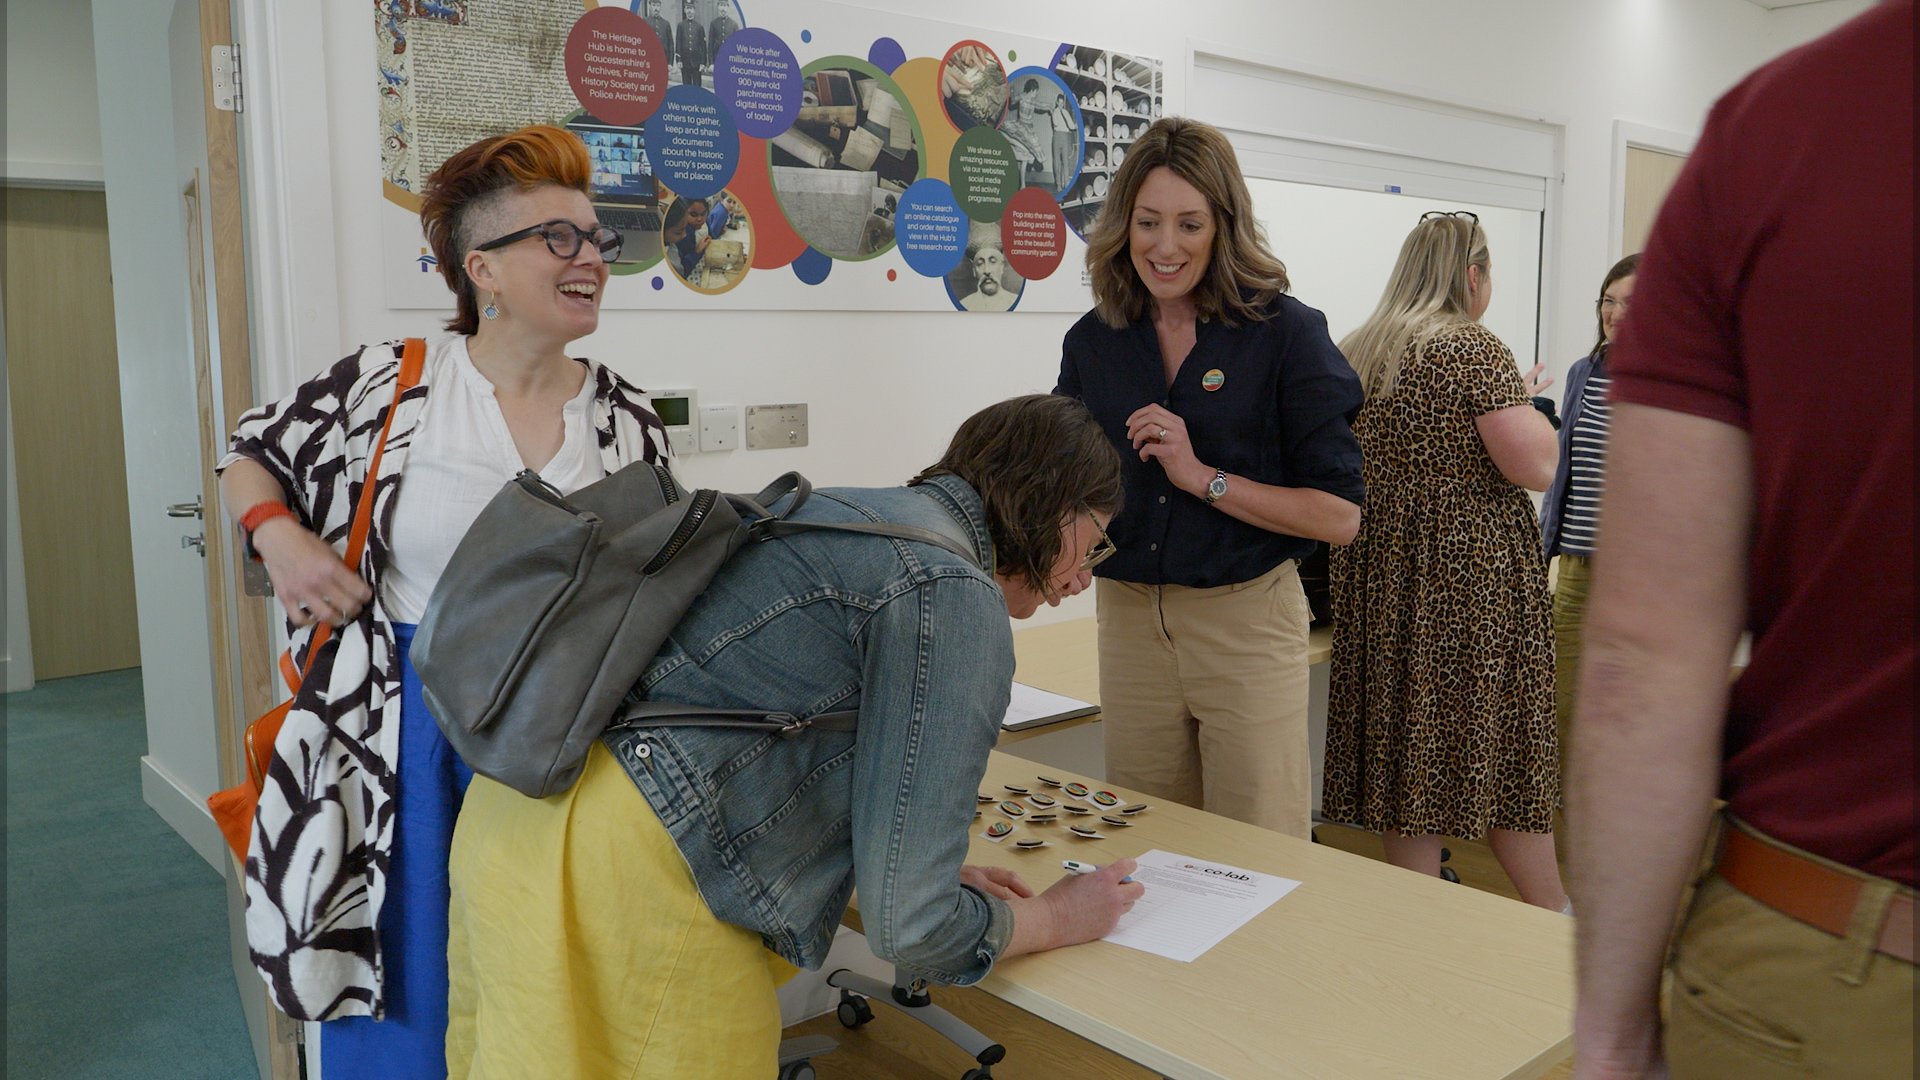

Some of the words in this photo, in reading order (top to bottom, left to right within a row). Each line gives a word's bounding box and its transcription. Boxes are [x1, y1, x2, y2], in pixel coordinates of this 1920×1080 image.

[592, 30, 607, 39] The
[609, 33, 641, 45] Heritage
[588, 42, 605, 51] Hub
[607, 44, 613, 52] is
[615, 45, 637, 55] home
[736, 44, 748, 52] We
[749, 46, 764, 54] look
[765, 48, 780, 57] after
[584, 53, 650, 68] Gloucestershire's
[729, 55, 755, 65] millions
[764, 61, 788, 69] unique
[587, 66, 621, 77] Archives,
[623, 70, 648, 81] Family
[730, 66, 770, 78] documents,
[772, 70, 787, 79] from
[581, 77, 608, 88] History
[610, 80, 638, 91] Society
[738, 78, 752, 86] 900
[753, 80, 780, 90] year-old
[590, 89, 613, 99] Police
[615, 92, 647, 103] Archives
[737, 90, 773, 100] parchment
[667, 102, 680, 110] We
[681, 104, 699, 112] work
[736, 99, 757, 109] digital
[663, 114, 686, 122] others
[696, 117, 720, 127] gather,
[754, 112, 773, 123] today
[665, 124, 683, 134] keep
[685, 127, 698, 135] and
[700, 129, 720, 137] share
[672, 136, 713, 147] documents
[662, 147, 684, 156] about
[684, 149, 696, 157] the
[698, 150, 724, 159] historic
[665, 160, 696, 169] county's
[697, 162, 721, 171] people
[960, 156, 982, 165] amazing
[984, 158, 1008, 166] resources
[674, 171, 688, 179] and
[982, 168, 1006, 176] websites,
[981, 187, 1000, 195] activity
[931, 215, 959, 223] catalogue
[1013, 211, 1023, 219] Pop
[1013, 221, 1034, 229] building
